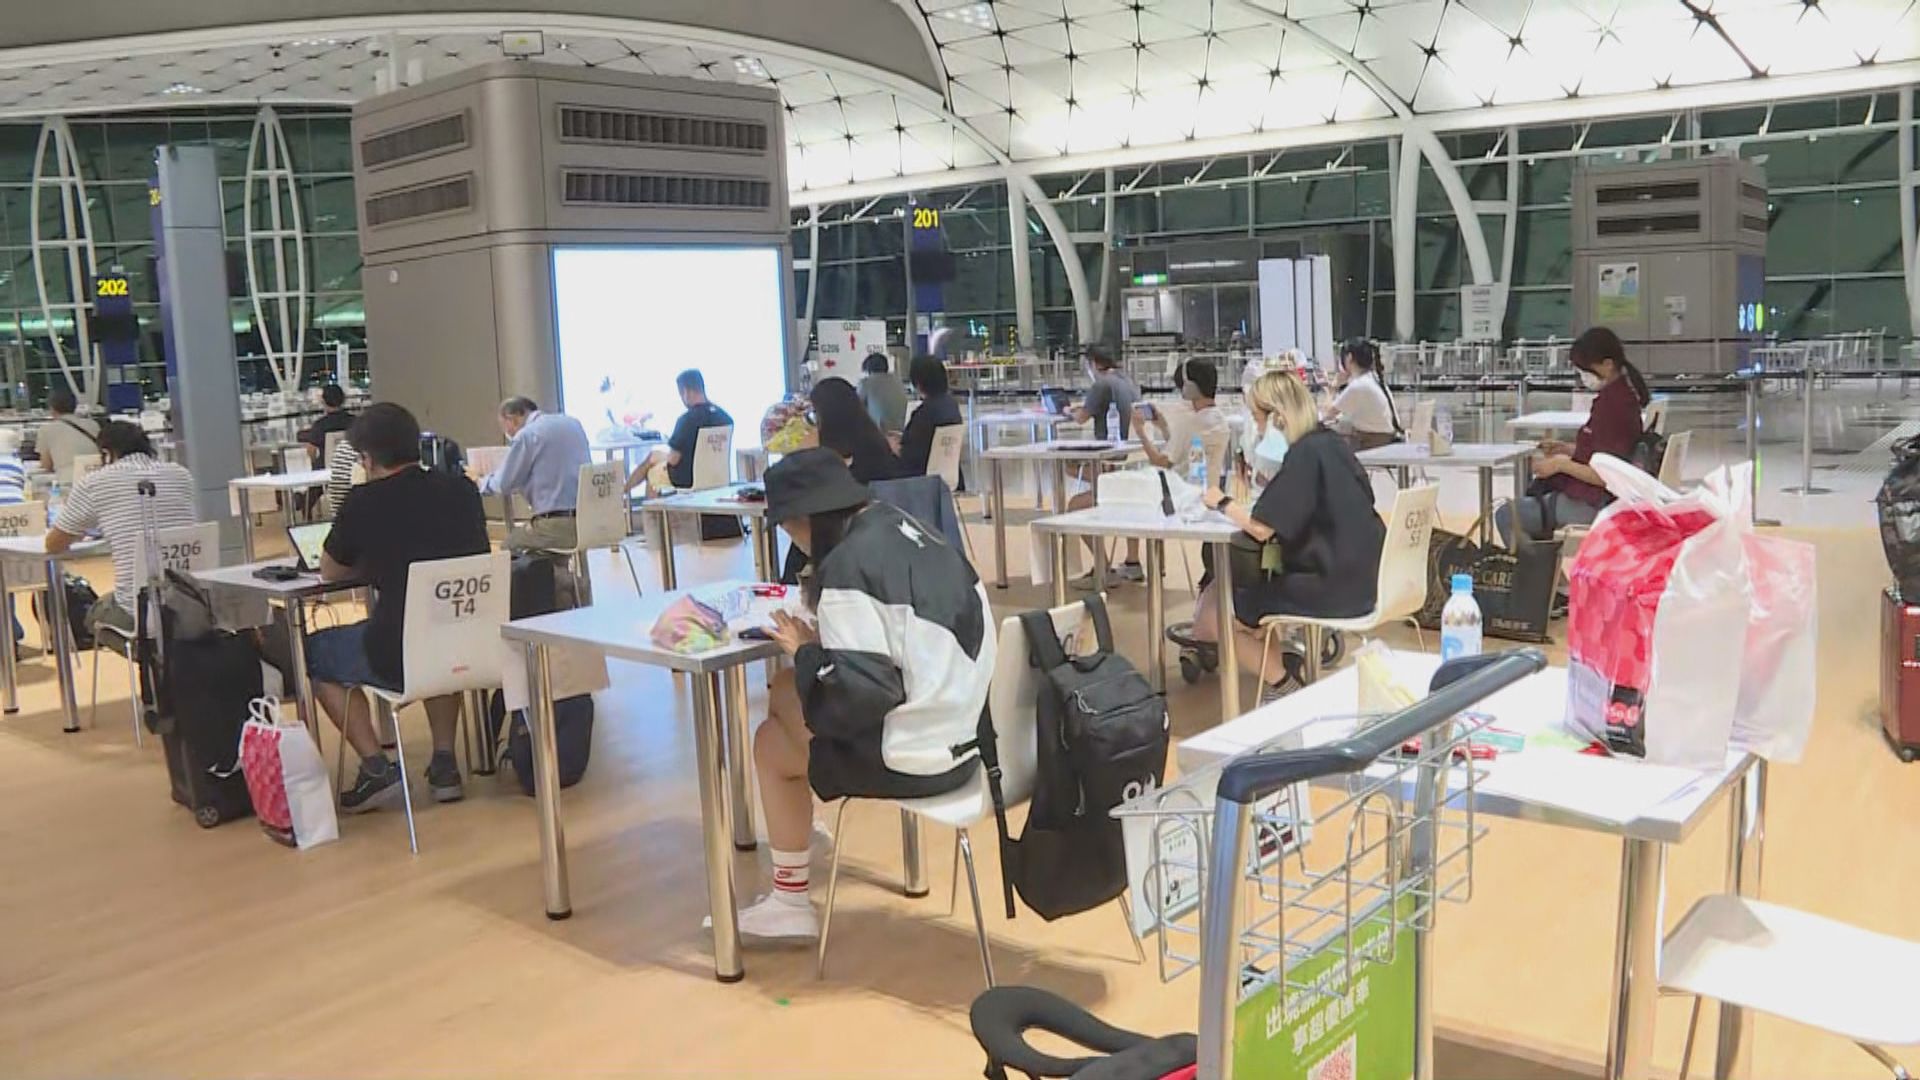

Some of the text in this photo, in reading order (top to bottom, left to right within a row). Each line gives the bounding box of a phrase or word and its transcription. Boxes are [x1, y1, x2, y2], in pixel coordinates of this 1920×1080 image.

[914, 208, 939, 228] 201
[97, 279, 128, 296] 202
[821, 343, 840, 353] G206
[0, 514, 29, 529] 206
[435, 573, 492, 600] G206
[452, 597, 476, 617] T4
